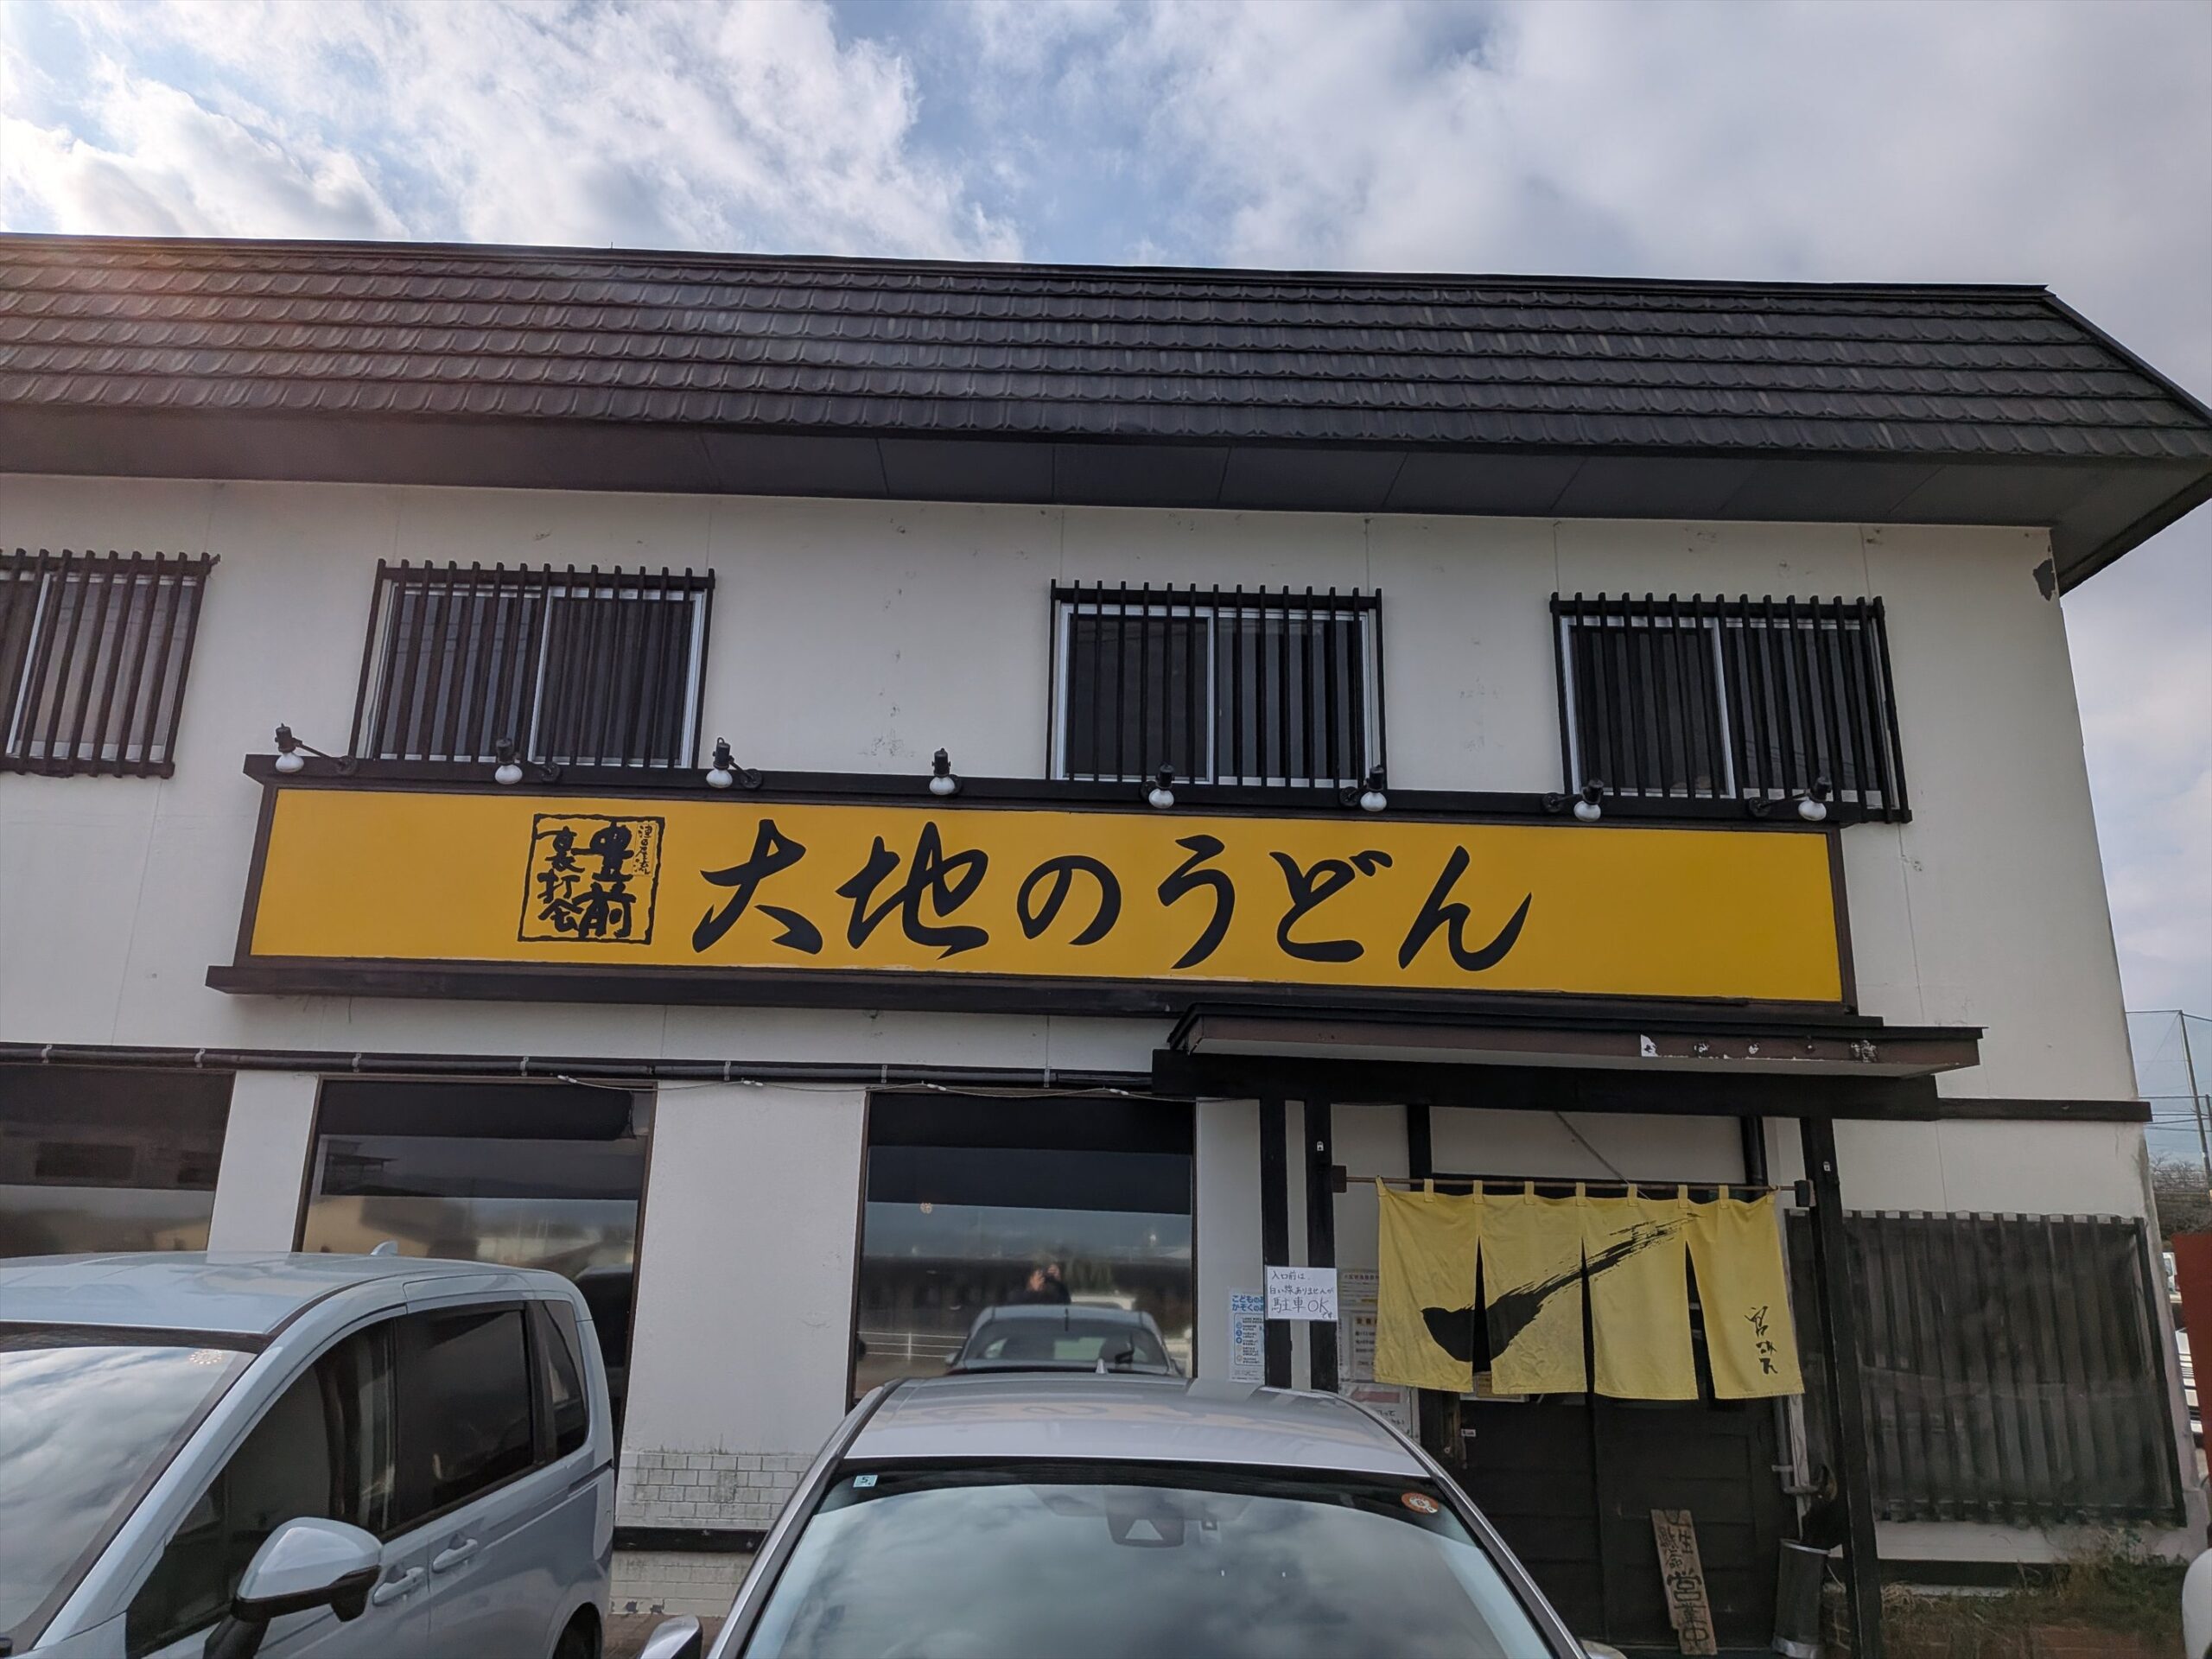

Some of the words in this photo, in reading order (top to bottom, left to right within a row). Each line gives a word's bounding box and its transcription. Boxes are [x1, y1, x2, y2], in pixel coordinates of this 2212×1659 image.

[691, 819, 1533, 971] 大地のうどん
